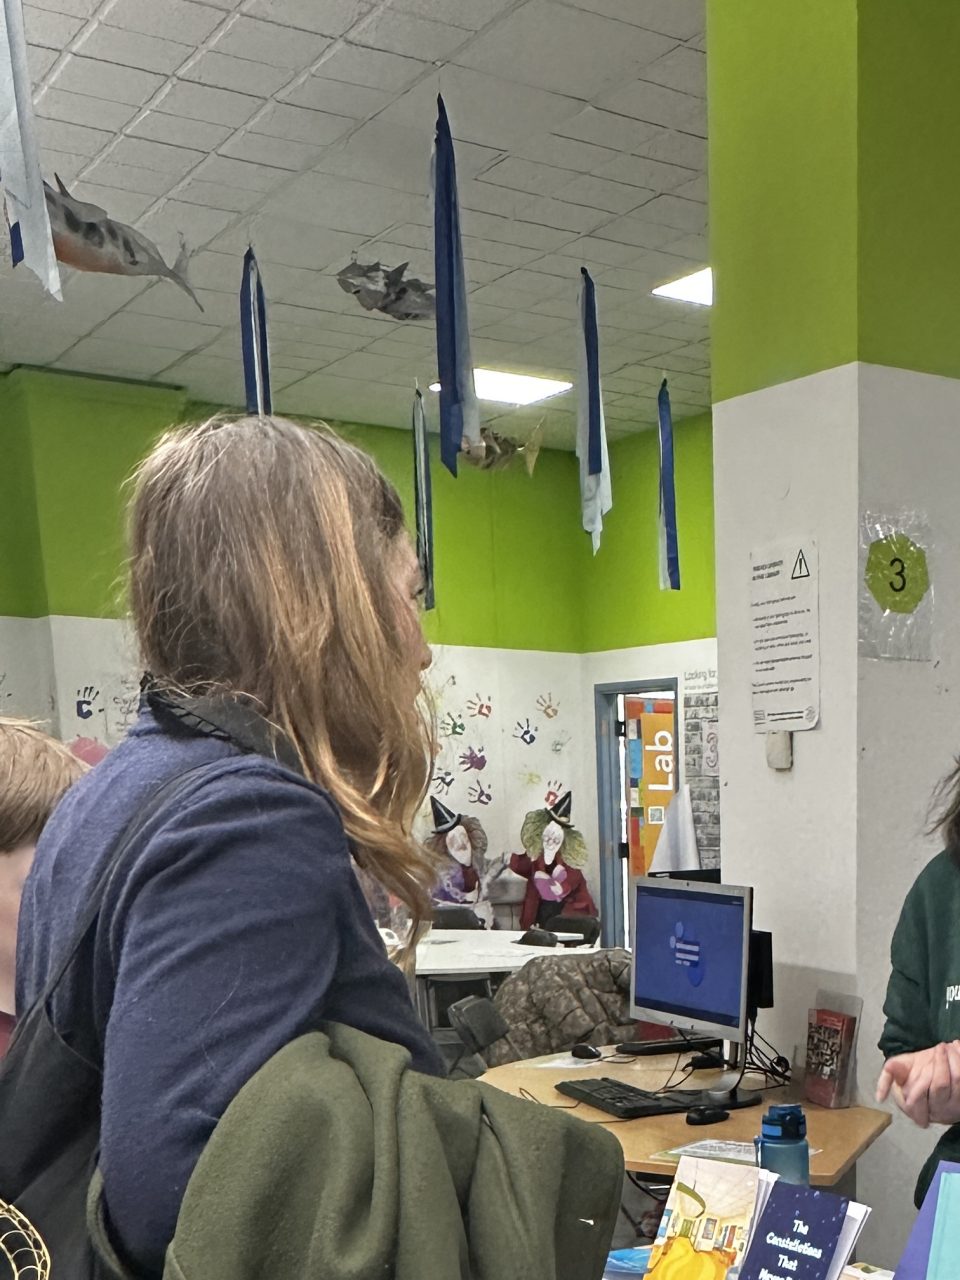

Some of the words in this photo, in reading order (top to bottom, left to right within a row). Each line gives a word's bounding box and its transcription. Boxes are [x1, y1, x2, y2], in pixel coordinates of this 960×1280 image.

[888, 557, 907, 593] 3
[645, 730, 673, 791] Lab
[793, 1219, 809, 1235] The
[778, 1254, 798, 1271] That
